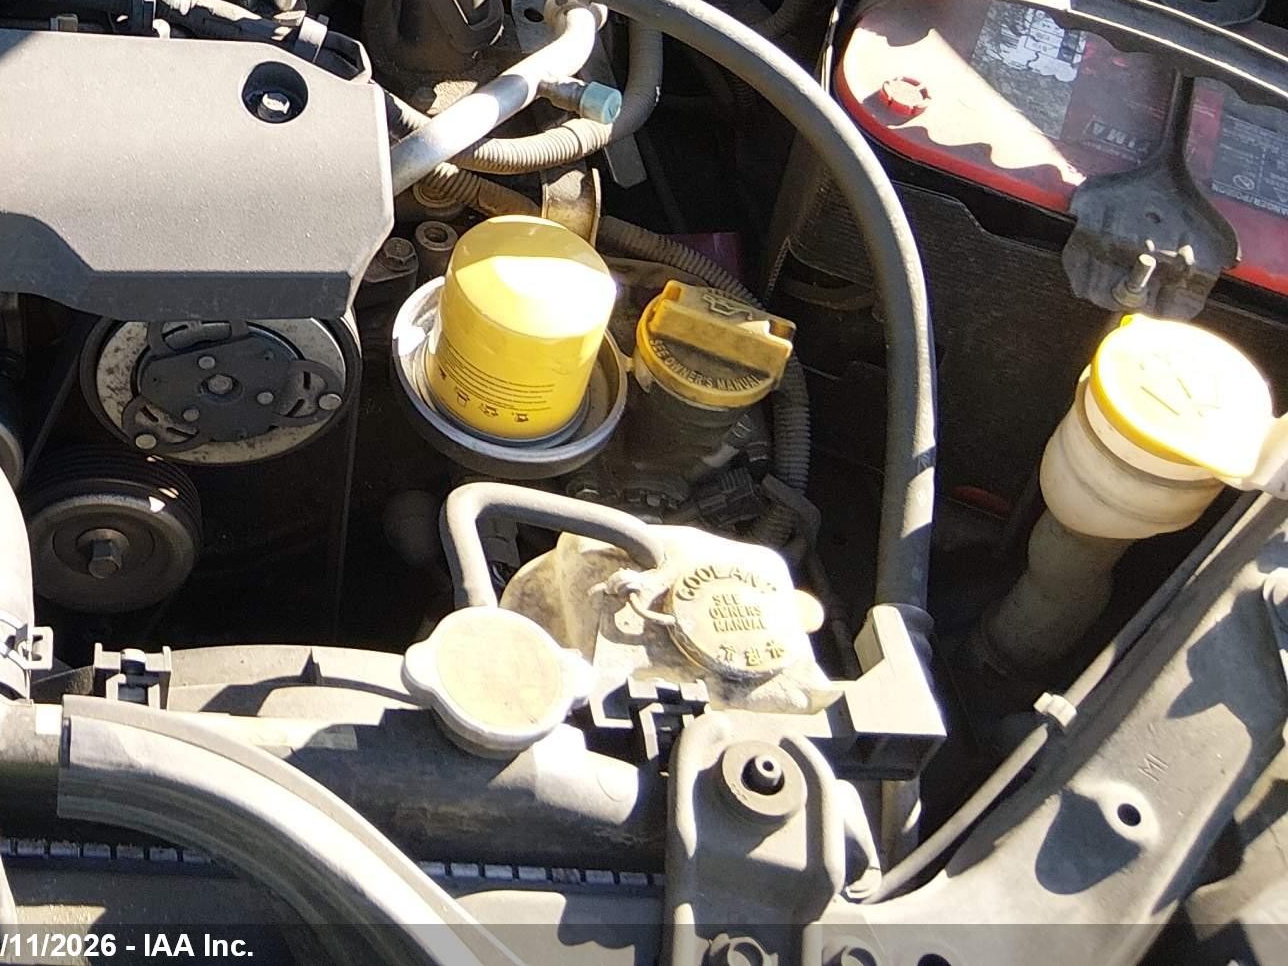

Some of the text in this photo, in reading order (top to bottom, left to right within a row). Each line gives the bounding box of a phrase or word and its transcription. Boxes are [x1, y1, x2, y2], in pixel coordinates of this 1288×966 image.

[649, 338, 762, 392] SEE OWNER'S MANUAL
[711, 593, 740, 606] SEE
[712, 618, 768, 634] MANUAL
